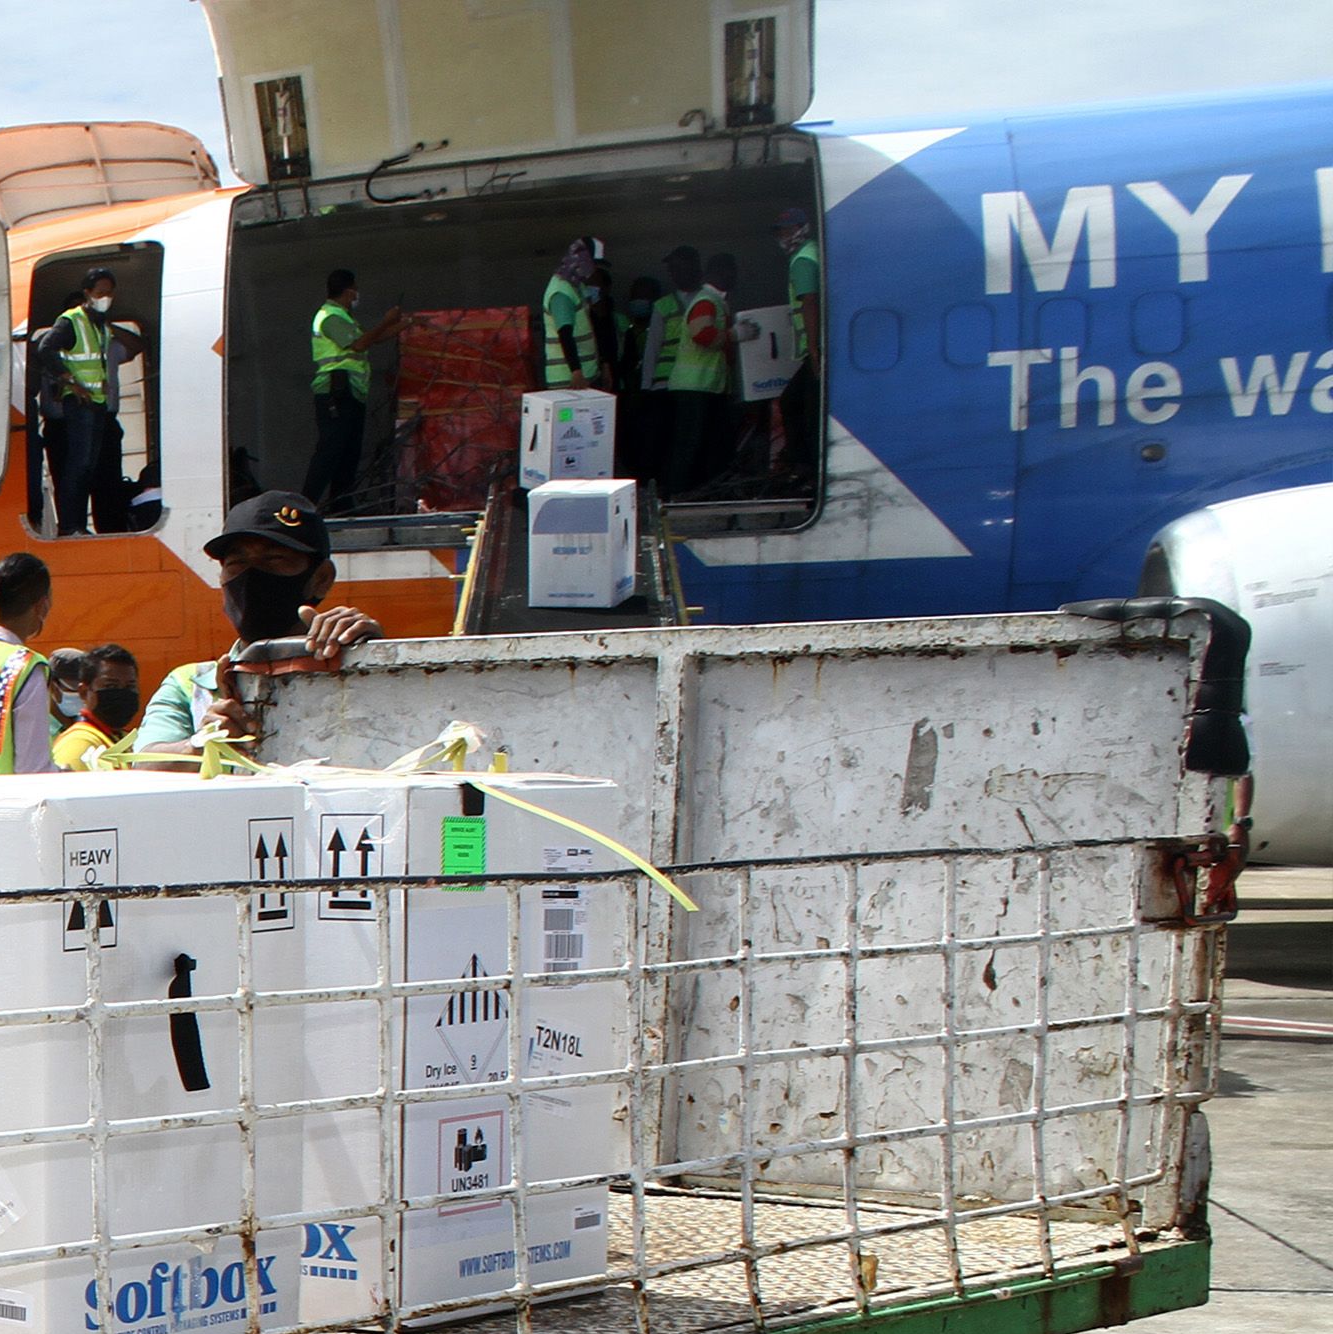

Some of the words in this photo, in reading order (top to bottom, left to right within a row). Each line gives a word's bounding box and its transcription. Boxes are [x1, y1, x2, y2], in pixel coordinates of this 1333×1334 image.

[982, 173, 1254, 295] MY
[987, 346, 1183, 432] The
[70, 849, 112, 867] HEAVY
[536, 1025, 583, 1058] T2N18L
[426, 1064, 444, 1079] Dry
[444, 1063, 457, 1075] Ice
[470, 1054, 477, 1066] 9
[451, 1173, 489, 1192] UN3481
[85, 1255, 277, 1330] Softbox
[209, 1302, 240, 1325] SYSTEMS
